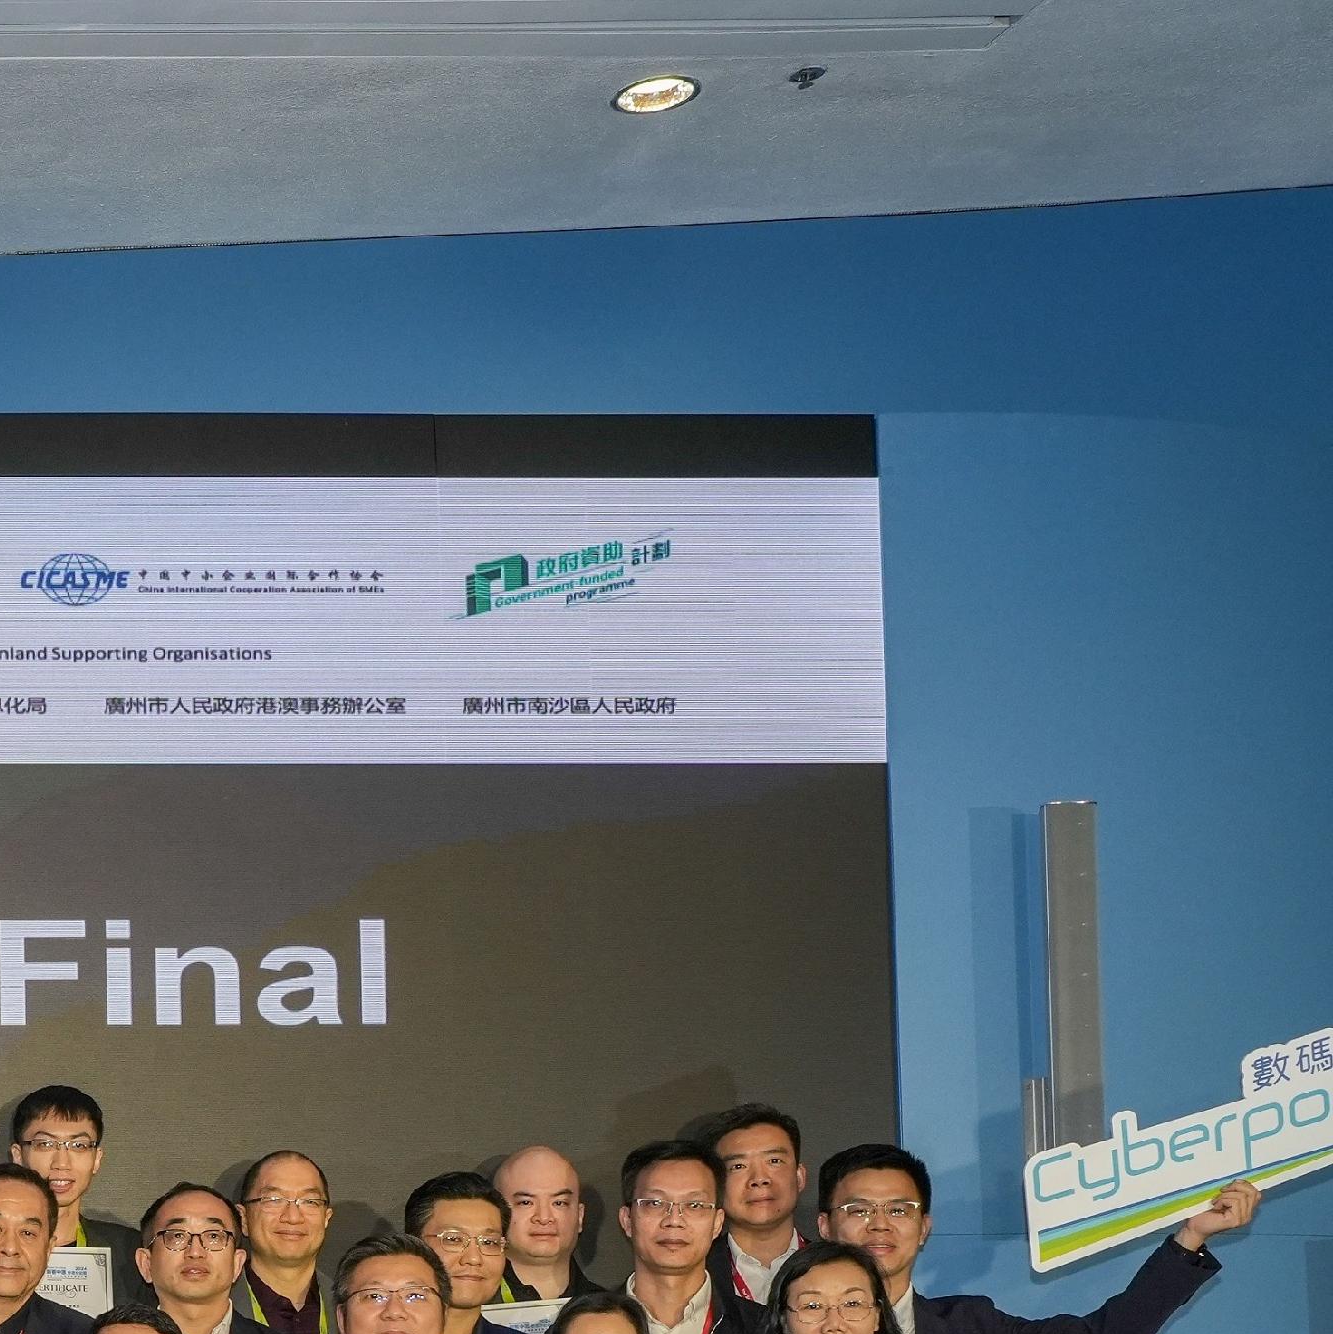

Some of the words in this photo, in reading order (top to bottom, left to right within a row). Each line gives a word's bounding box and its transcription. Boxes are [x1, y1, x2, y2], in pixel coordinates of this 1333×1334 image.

[20, 571, 130, 589] CICASME
[495, 566, 624, 607] Government-funded
[566, 578, 635, 604] programme
[52, 646, 148, 664] Supporting
[153, 646, 272, 663] Organisations
[105, 696, 407, 715] 廣州市人民政府港澳事務辦公室
[462, 696, 675, 715] 廣州市南沙區人民政府
